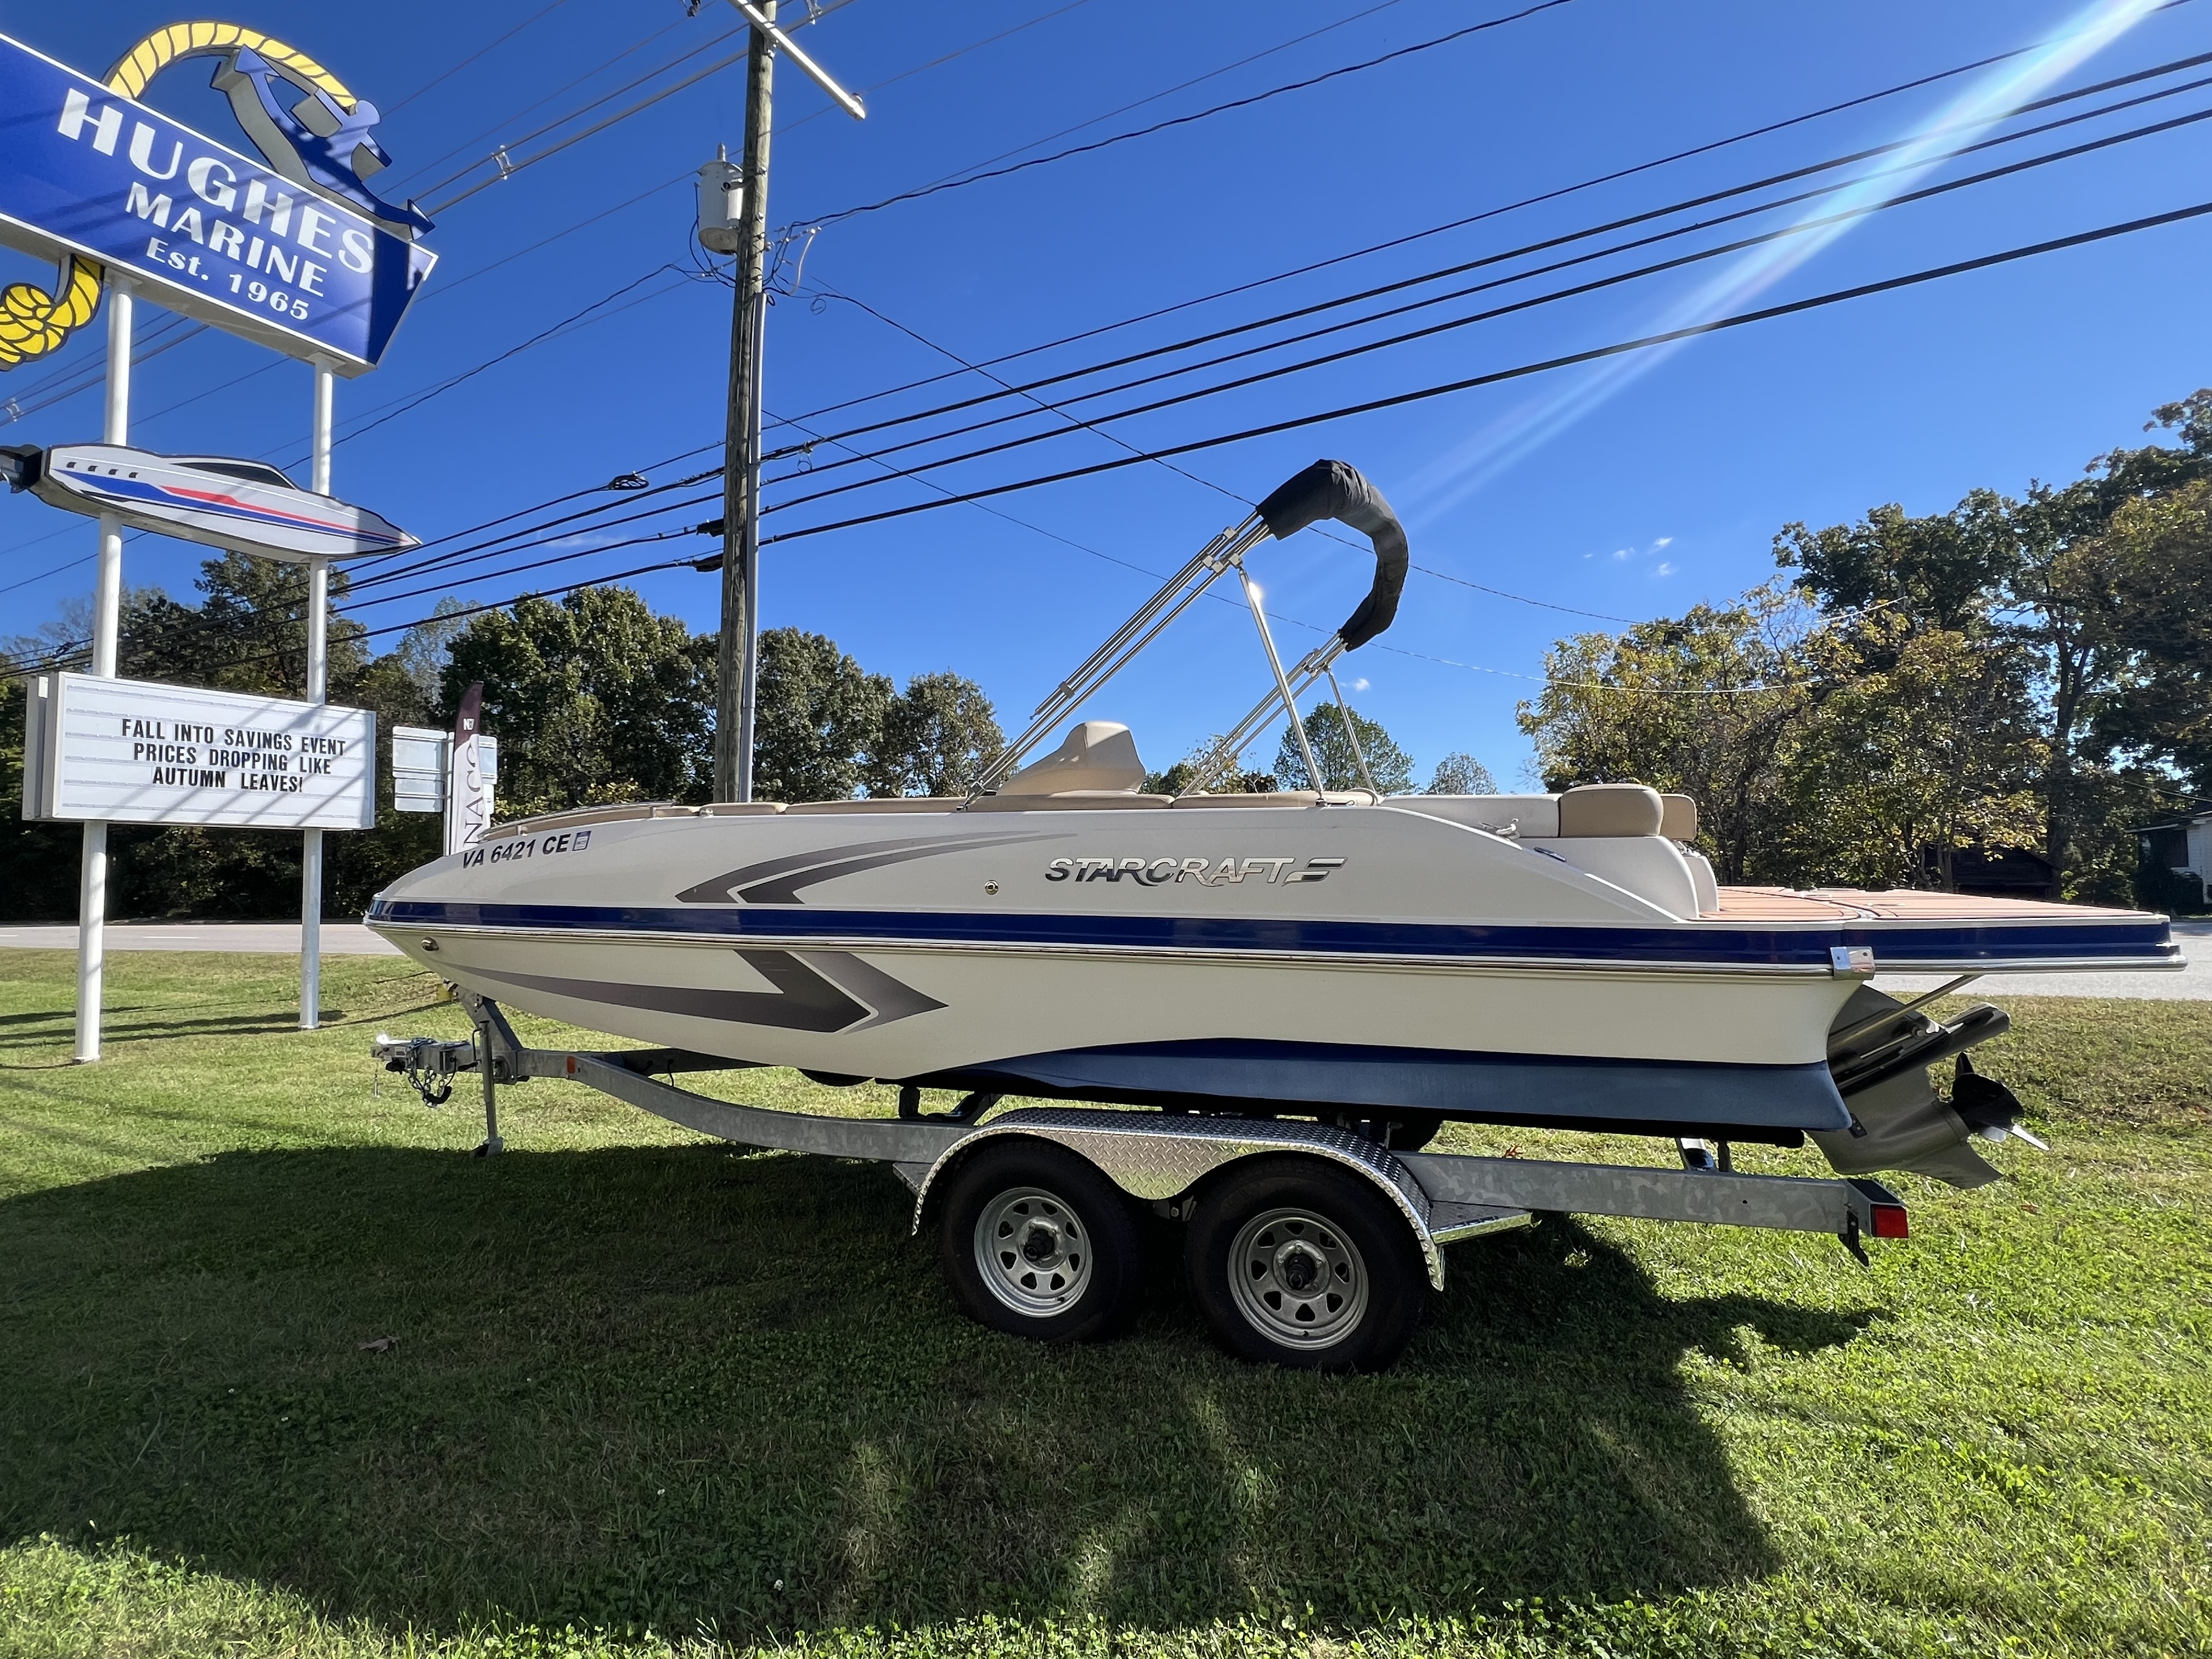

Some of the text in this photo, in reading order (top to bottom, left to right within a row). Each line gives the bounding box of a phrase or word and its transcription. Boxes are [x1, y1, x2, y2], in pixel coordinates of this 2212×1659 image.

[58, 87, 375, 274] HUGHES
[125, 182, 328, 297] MARINE
[146, 238, 309, 320] Est. 1965
[122, 719, 346, 756] FALL INTO SAVINGS EVENT
[134, 743, 331, 774] PRICES DROPPING LIKE
[153, 766, 303, 793] AUTUMN LEAVES!
[463, 849, 484, 868] VA
[490, 839, 537, 864] 6421
[543, 833, 571, 855] CE
[1045, 857, 1295, 887] STARCRAFT
